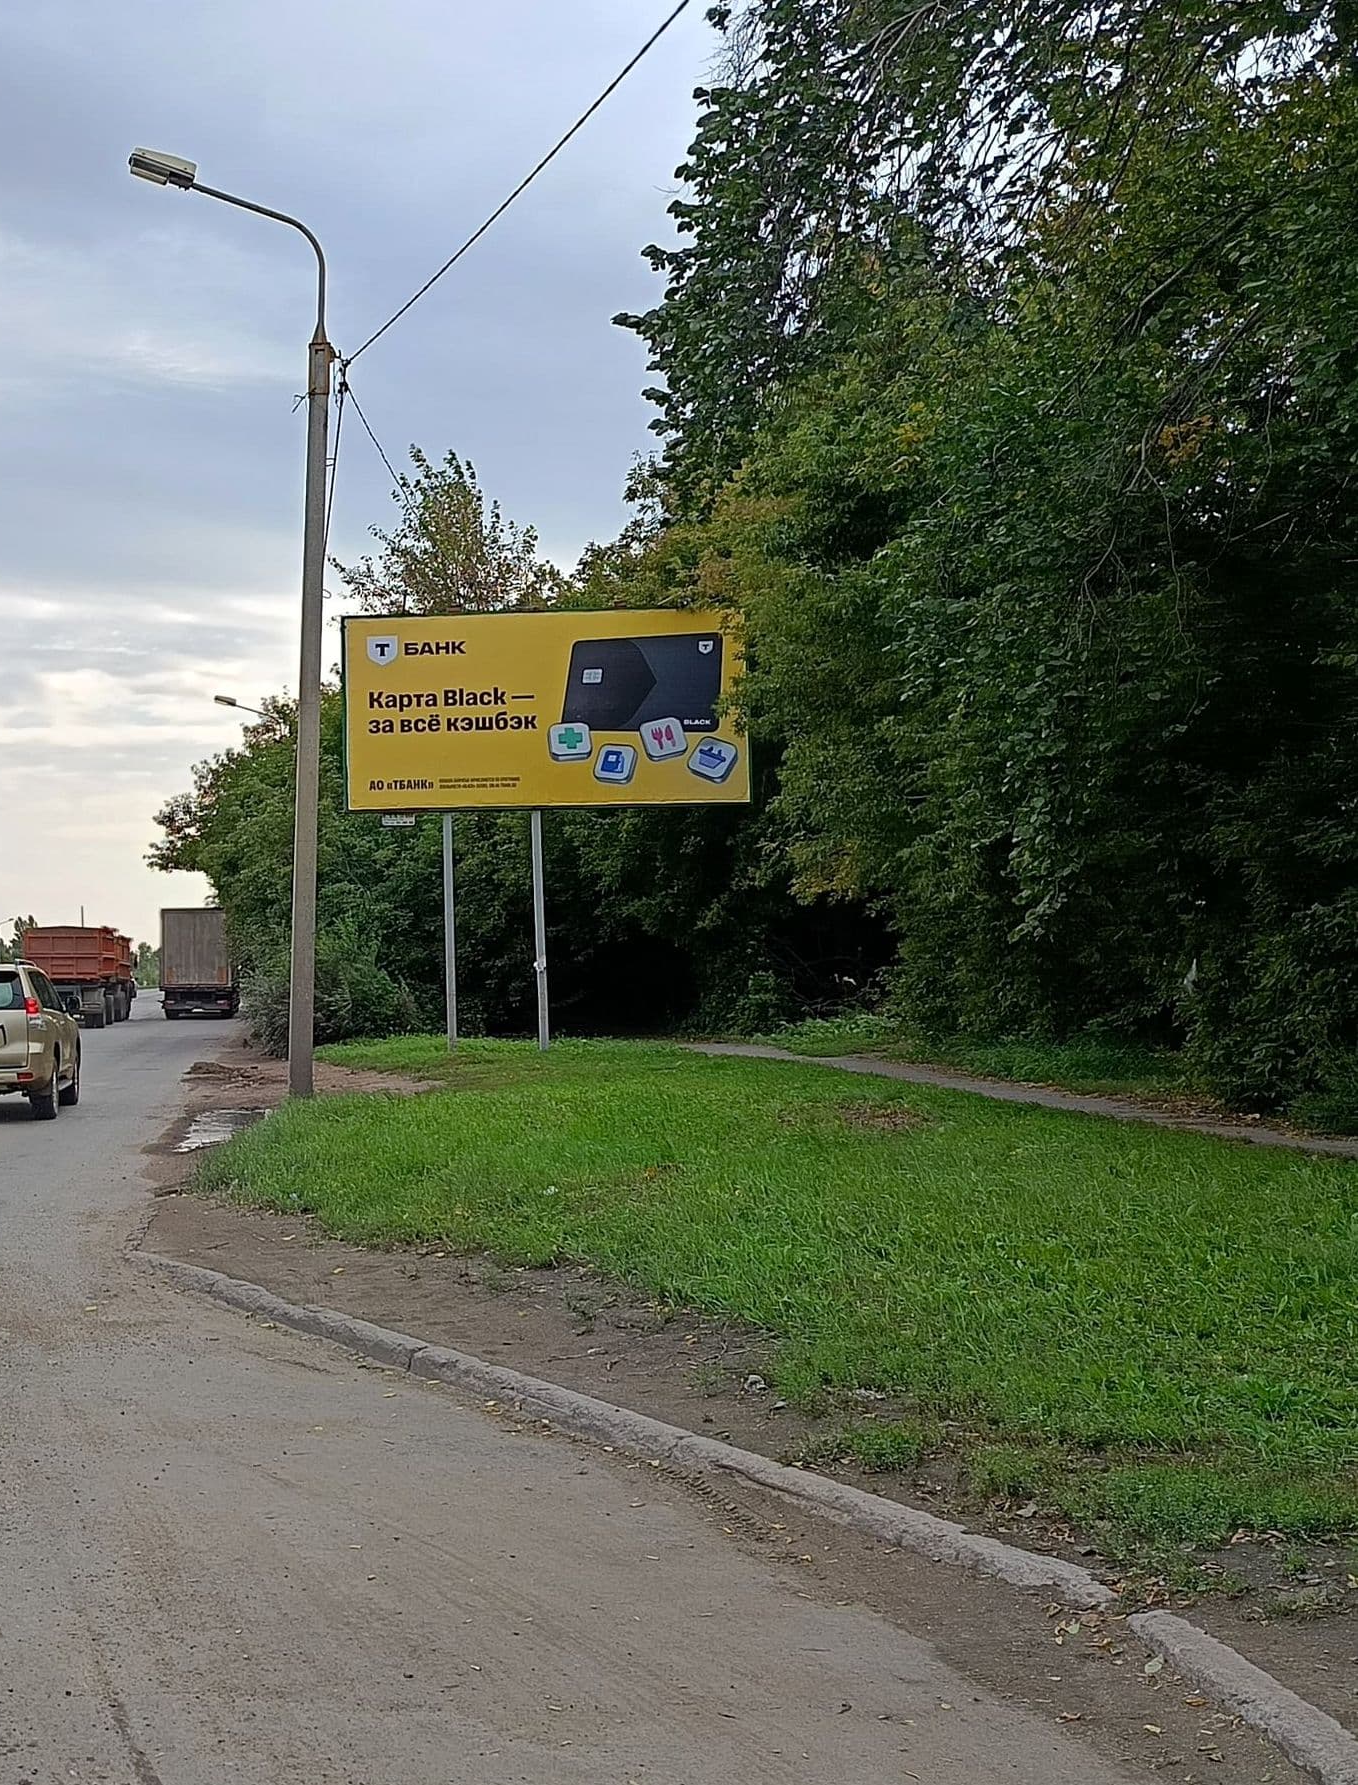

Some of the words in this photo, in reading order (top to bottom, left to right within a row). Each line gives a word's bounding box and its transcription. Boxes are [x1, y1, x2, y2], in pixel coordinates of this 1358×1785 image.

[403, 640, 467, 656] БАНК
[368, 690, 438, 712] Карта
[443, 687, 507, 707] Black
[368, 718, 395, 734] за
[400, 714, 441, 733] всё
[446, 711, 537, 732] кэшбэк
[369, 779, 384, 791] АО
[386, 778, 434, 791] «ТБАНК»
